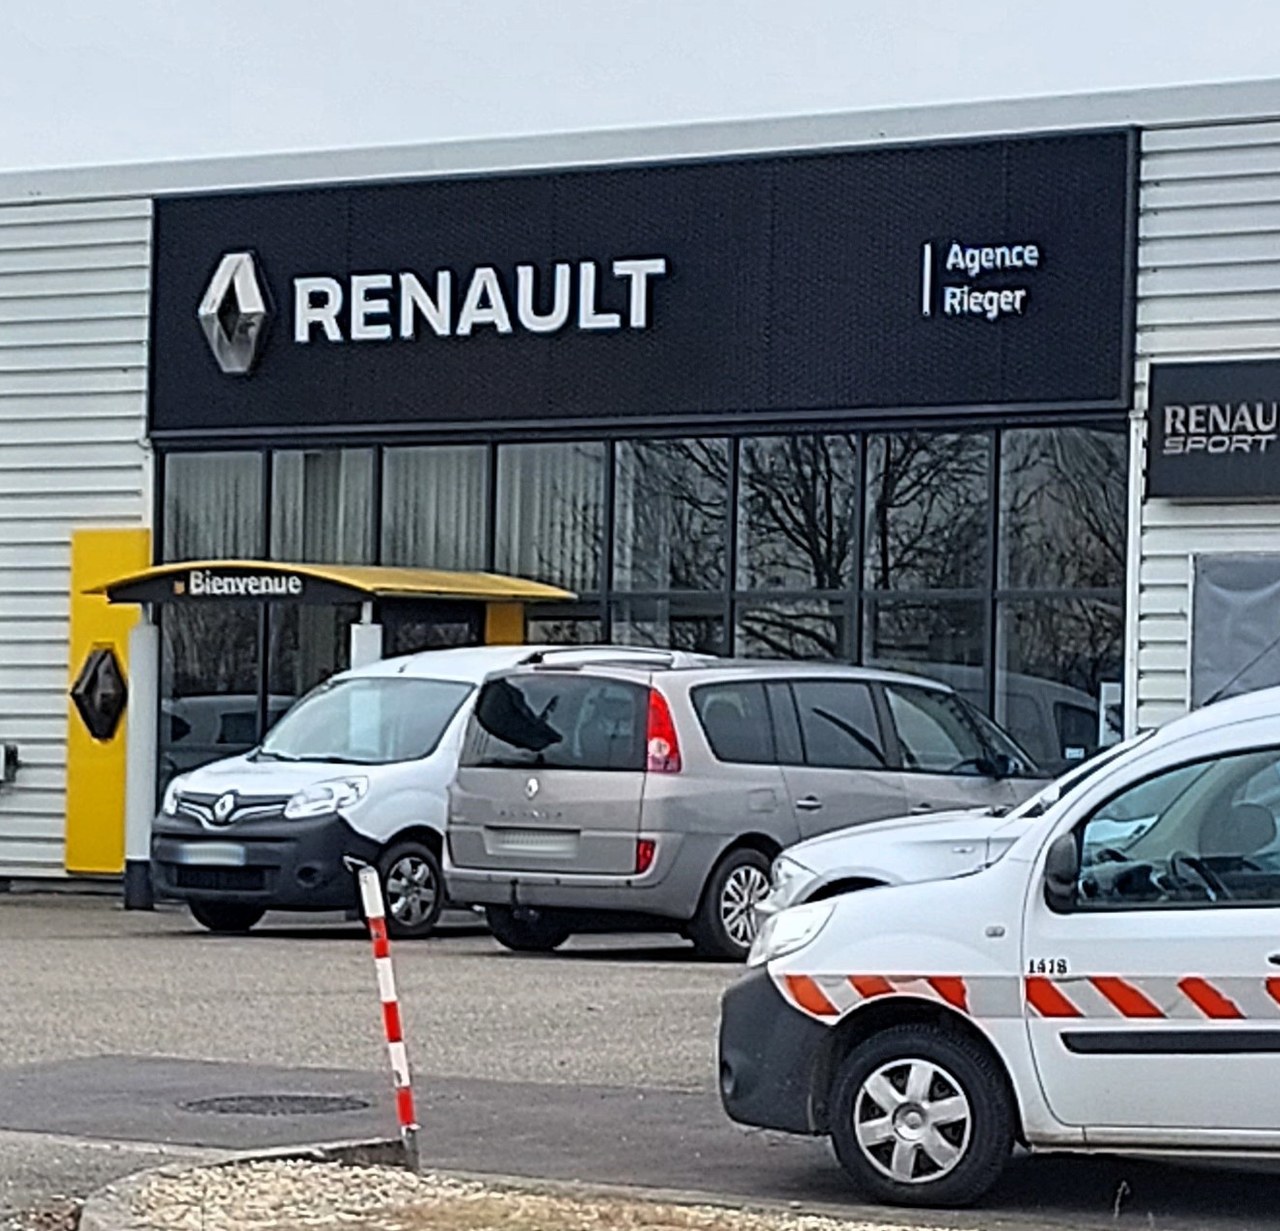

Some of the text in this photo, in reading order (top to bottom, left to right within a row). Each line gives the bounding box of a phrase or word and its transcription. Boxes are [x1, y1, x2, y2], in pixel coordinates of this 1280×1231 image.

[946, 242, 1039, 277] Agence
[294, 258, 666, 342] RENAULT
[943, 286, 1026, 320] Rieger
[1163, 434, 1277, 455] SPORT
[189, 570, 302, 595] Bienvenue
